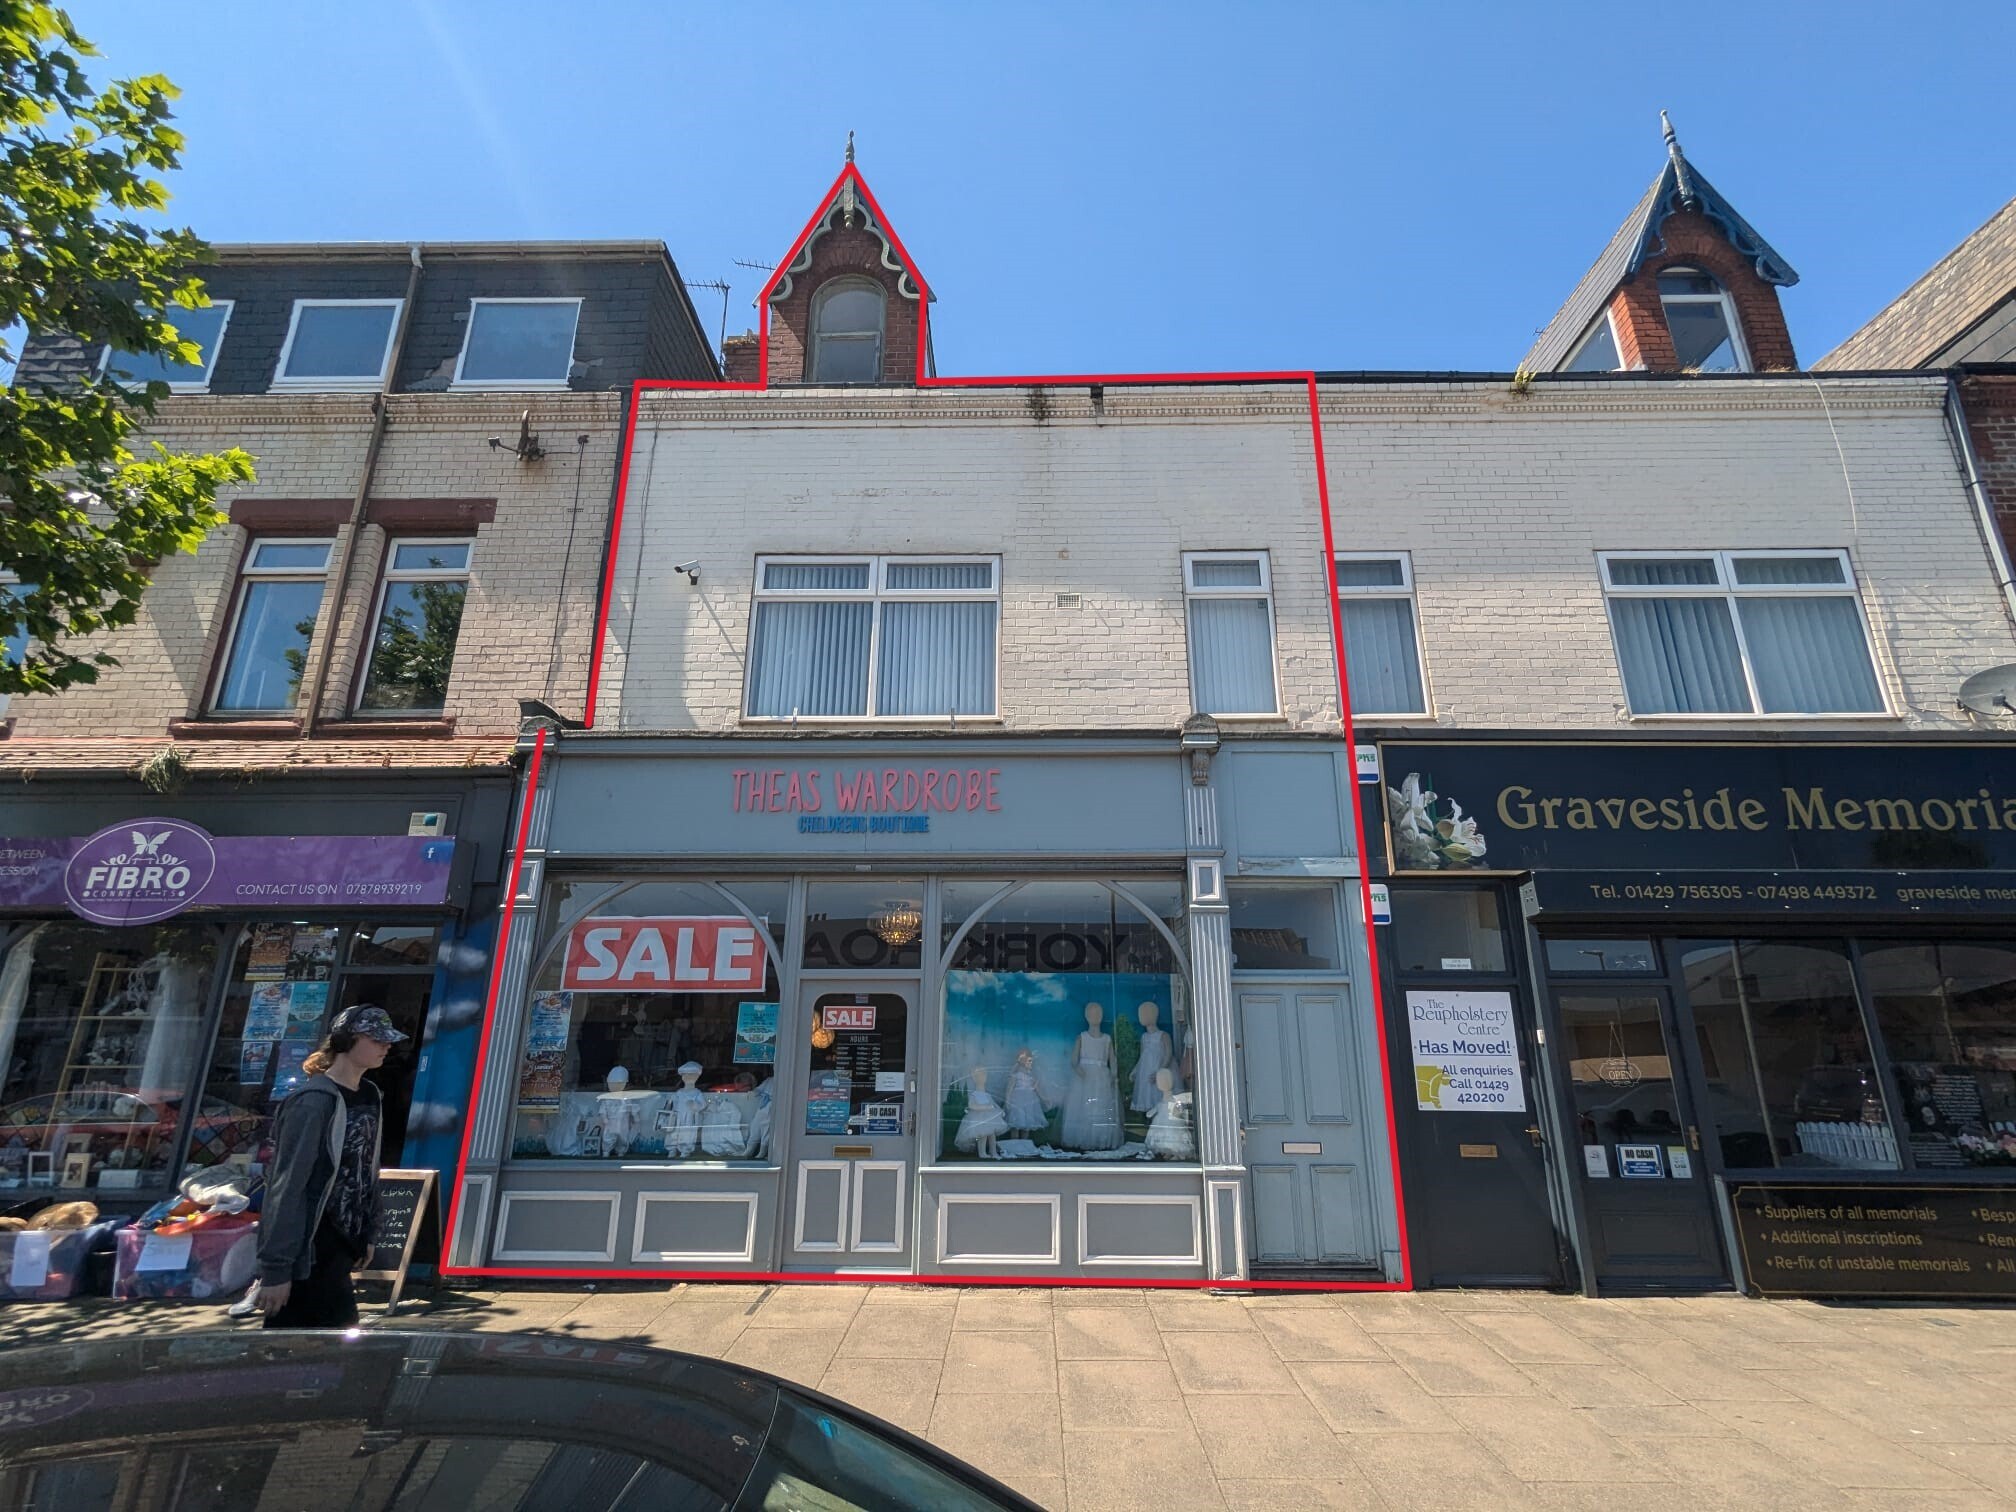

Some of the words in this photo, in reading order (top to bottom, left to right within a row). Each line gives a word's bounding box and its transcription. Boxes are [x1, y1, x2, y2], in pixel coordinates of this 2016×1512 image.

[731, 768, 822, 813] THEAS
[835, 768, 1004, 813] WARDROBE
[1497, 785, 1769, 831] Graveside
[0, 849, 46, 860] ETWEEN
[0, 865, 40, 876] ESSION
[85, 866, 191, 890] FIBRO
[236, 884, 296, 895] CONTACT
[298, 884, 314, 895] US
[317, 884, 338, 895] ON
[346, 884, 423, 895] 07878939219
[1590, 884, 1621, 899] Tel.
[1625, 884, 1675, 899] 01429
[1678, 885, 1742, 899] 756305
[1757, 885, 1810, 900] 07498
[1813, 885, 1877, 900] 449372
[1896, 885, 1981, 902] graveside
[576, 927, 755, 981] SALE
[1427, 999, 1444, 1009] The
[825, 1010, 873, 1026] SALE
[1412, 1005, 1508, 1026] Reupholstery
[1457, 1022, 1500, 1036] Centre
[1419, 1040, 1449, 1054] Has
[1453, 1040, 1511, 1054] Moved!
[1442, 1065, 1458, 1075] All
[1460, 1065, 1514, 1077] enquiries
[1608, 1070, 1633, 1080] OPEN
[1449, 1079, 1473, 1089] Call
[1475, 1080, 1509, 1091] 01429
[1457, 1093, 1505, 1104] 420200
[879, 1107, 897, 1117] CASH
[1624, 1149, 1635, 1159] NO
[1636, 1149, 1654, 1159] CASH
[1764, 1205, 1827, 1222] Suppliers
[1829, 1206, 1845, 1219] of
[1847, 1206, 1864, 1220] all
[1866, 1206, 1938, 1221] memorials
[1980, 1207, 2016, 1223] Besp
[1771, 1230, 1841, 1245] Additional
[1843, 1231, 1923, 1249] inscriptions
[1987, 1233, 2016, 1247] Ren
[1774, 1255, 1816, 1270] Re-fix
[1817, 1255, 1834, 1269] of
[1837, 1256, 1896, 1271] unstable
[1898, 1257, 1971, 1272] memorials
[1997, 1258, 2016, 1273] All
